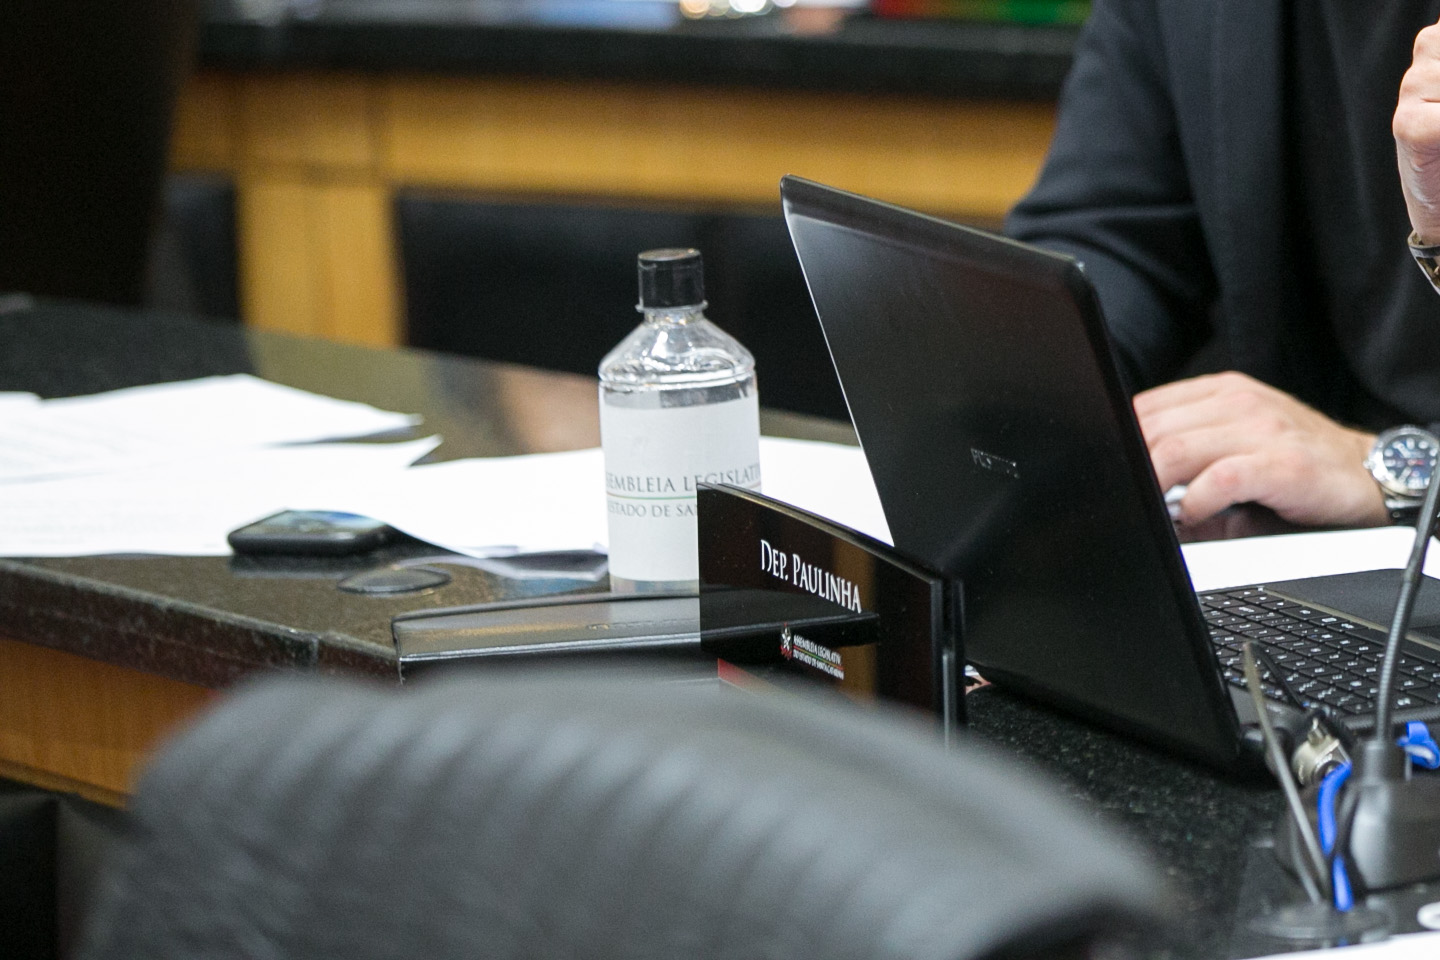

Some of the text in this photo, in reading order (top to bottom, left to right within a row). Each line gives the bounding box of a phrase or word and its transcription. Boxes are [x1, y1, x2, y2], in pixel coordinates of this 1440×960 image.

[651, 504, 669, 518] DE
[676, 502, 698, 518] SA
[792, 553, 862, 614] PAULINHA
